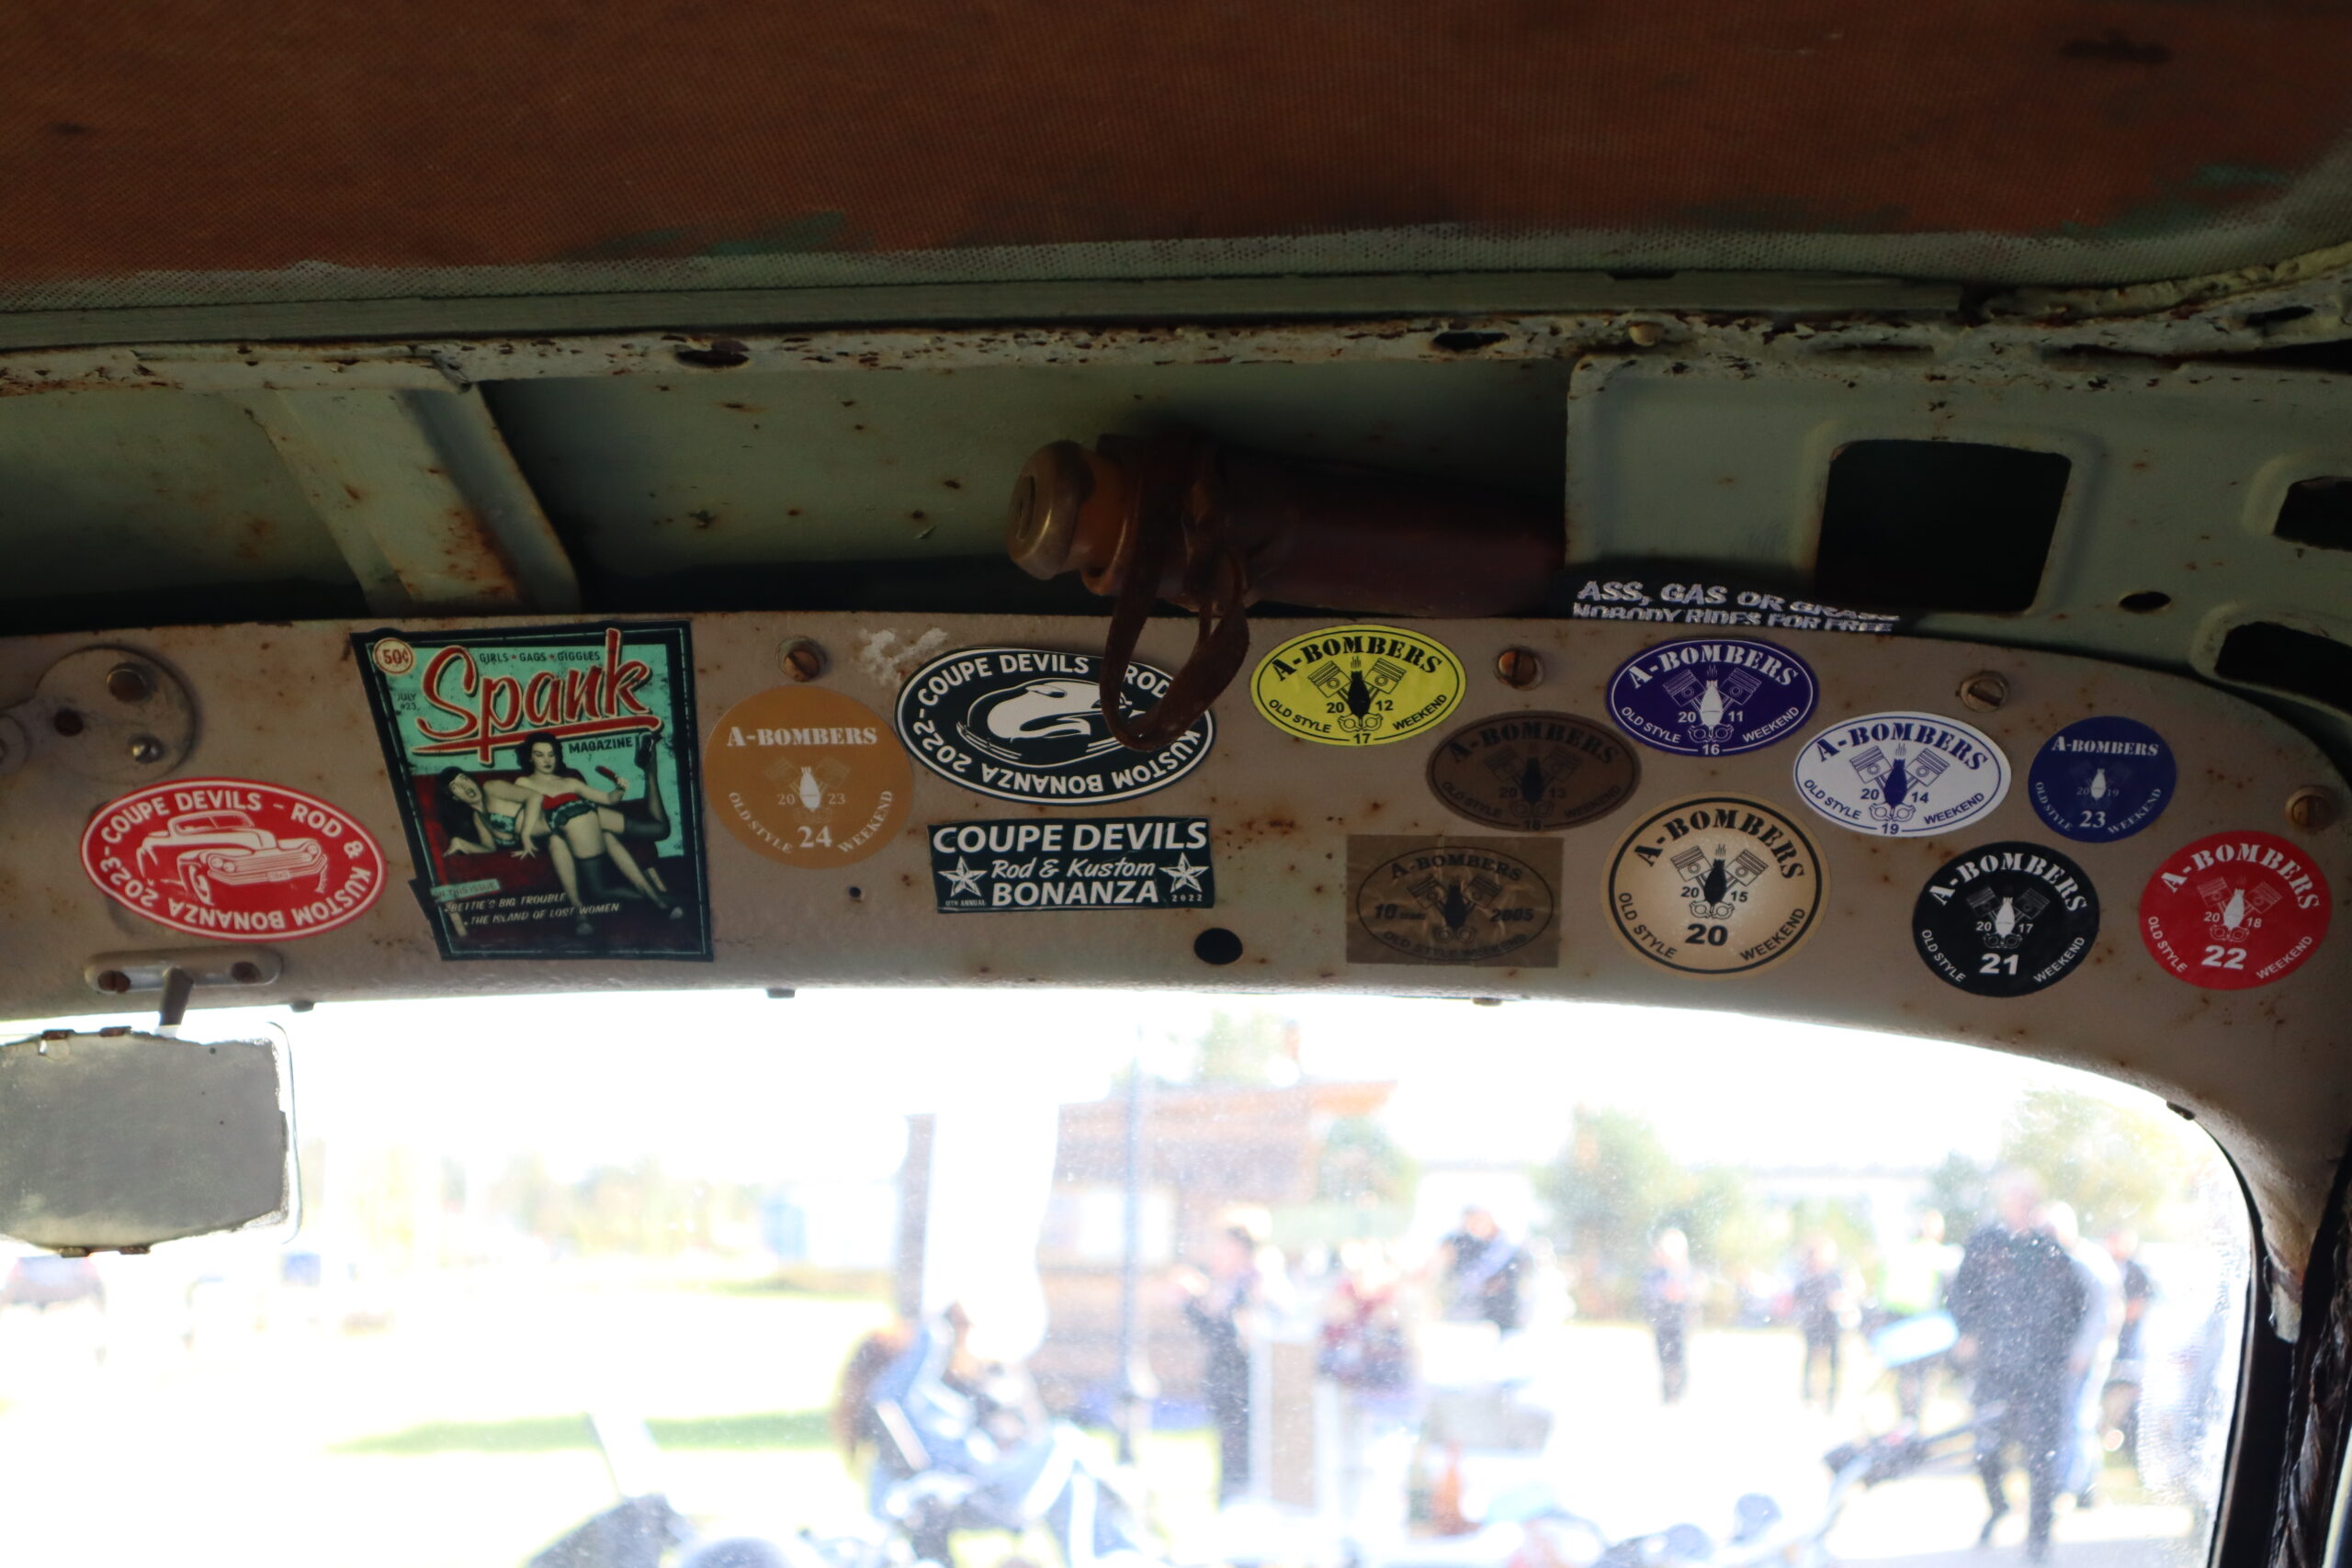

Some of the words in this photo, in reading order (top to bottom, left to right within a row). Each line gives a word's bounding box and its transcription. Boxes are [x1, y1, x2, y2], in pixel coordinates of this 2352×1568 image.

[1577, 581, 1654, 606] ASS,
[1660, 583, 1728, 605] GAS
[1737, 591, 1786, 611] OR
[1767, 613, 1822, 630] FOR
[1823, 618, 1894, 632] FREE
[382, 649, 410, 665] 50¢
[479, 651, 509, 662] GIRLS
[519, 651, 547, 662] GAGS
[557, 650, 600, 661] GIGGLES
[1272, 636, 1442, 682] A-BOMBERS
[1627, 644, 1799, 689] A-BOMBERS
[918, 656, 993, 707] COUPE
[1000, 653, 1090, 675] DEVILS
[1123, 664, 1171, 699] ROD
[397, 693, 416, 701] JULY
[413, 628, 660, 764] Spank
[1326, 702, 1344, 713] 20
[1375, 700, 1393, 712] 12
[1269, 698, 1293, 717] OLD
[1293, 714, 1331, 734] STYLE
[1392, 694, 1447, 731] WEEKEND
[1622, 705, 1644, 726] OLD
[1643, 722, 1681, 744] STYLE
[1678, 711, 1697, 723] 20
[1728, 711, 1744, 722] 11
[1742, 706, 1800, 743] WEEKEND
[569, 737, 633, 754] MAGAZINE
[726, 727, 878, 747] A-BOMBERS
[912, 719, 973, 773] 2022
[1353, 733, 1371, 744] 17
[1448, 721, 1621, 764] A-BOMBERS
[1702, 744, 1720, 755] 16
[1815, 722, 1988, 770] A-BOMBERS
[2052, 736, 2160, 757] A-BOMBERS
[1113, 730, 1202, 791] KUSTOM
[981, 762, 1104, 795] BONANZA
[1499, 787, 1516, 799] 20
[2076, 786, 2090, 795] 20
[777, 794, 796, 806] 20
[828, 794, 846, 806] 23
[1442, 781, 1464, 800] OLD
[1464, 798, 1502, 818] STYLE
[1564, 785, 1622, 818] WEEKEND
[1804, 779, 1826, 799] OLD
[1825, 796, 1862, 820] STYLE
[1860, 788, 1880, 800] 20
[1911, 791, 1929, 804] 14
[1923, 792, 1985, 825] WEEKEND
[2035, 781, 2049, 805] OLD
[2044, 804, 2074, 831] STYLE
[2107, 788, 2162, 834] WEEKEND
[100, 796, 170, 843] COUPE
[175, 790, 262, 812] DEVILS
[290, 802, 343, 839] ROD
[343, 840, 365, 858] &
[728, 792, 752, 821] OLD
[749, 820, 794, 854] STYLE
[837, 791, 893, 853] WEEKEND
[1881, 823, 1900, 835] 19
[2079, 810, 2107, 828] 23
[797, 826, 833, 848] 24
[933, 825, 1063, 853] COUPE
[1072, 822, 1207, 852] DEVILS
[1634, 808, 1804, 879] A-BOMBERS
[990, 859, 1035, 879] Rod
[1038, 858, 1060, 874] &
[1066, 857, 1156, 878] Kustom
[1390, 853, 1523, 881] A-BOMBERS
[1928, 852, 2087, 911] A-BOMBERS
[2161, 843, 2320, 909] A-BOMBERS
[292, 866, 371, 927] KUSTOM
[498, 897, 516, 908] BIG
[520, 893, 567, 906] TROUBLE
[960, 898, 987, 907] ANNUAL
[991, 880, 1159, 907] BONANZA
[1171, 893, 1204, 903] 2022
[1680, 886, 1700, 898] 20
[1730, 890, 1748, 902] 15
[166, 897, 286, 931] BONANZA
[470, 914, 489, 925] THE
[492, 910, 529, 923] ISLAND
[532, 909, 547, 919] OF
[549, 908, 574, 919] LOST
[579, 902, 620, 915] WOMEN
[1619, 892, 1638, 920] OLD
[1634, 923, 1677, 959] STYLE
[1975, 921, 1992, 931] 20
[2018, 923, 2034, 933] 17
[2203, 911, 2221, 922] 20
[2247, 917, 2262, 929] 18
[1384, 931, 1411, 948] OLD
[1684, 923, 1728, 947] 20
[1740, 908, 1805, 961] WEEKEND
[2147, 916, 2164, 940] OLD
[2156, 939, 2188, 974] STYLE
[1921, 929, 1939, 953] OLD
[1934, 953, 1966, 983] STYLE
[1979, 953, 2019, 976] 21
[2033, 936, 2086, 983] WEEKEND
[2201, 945, 2247, 970] 22
[2256, 935, 2313, 980] WEEKEND
